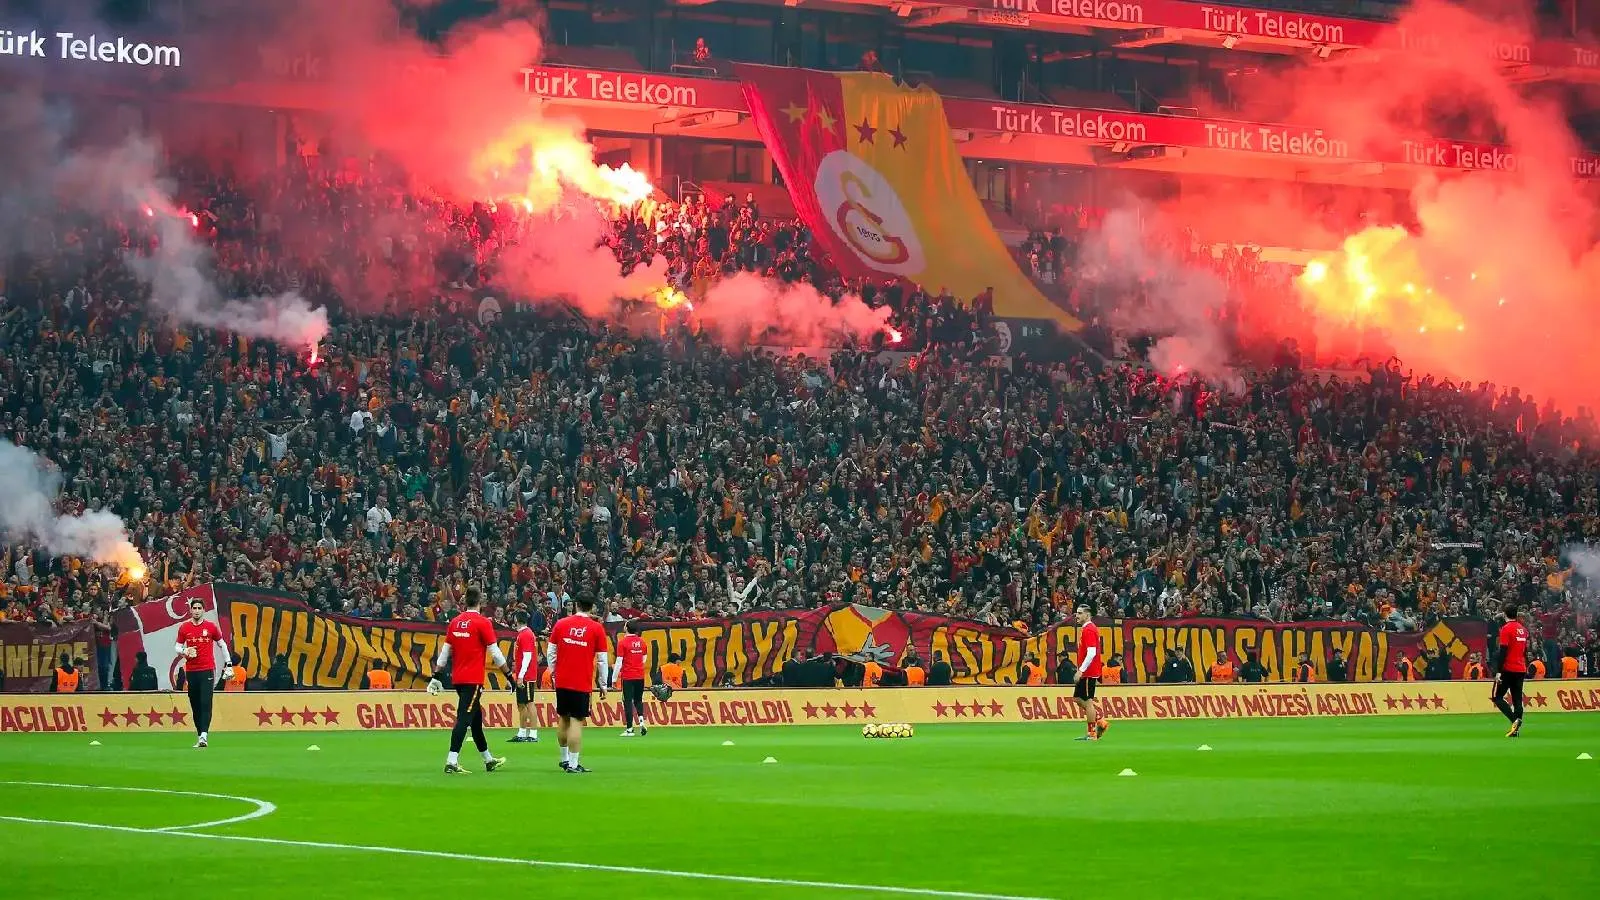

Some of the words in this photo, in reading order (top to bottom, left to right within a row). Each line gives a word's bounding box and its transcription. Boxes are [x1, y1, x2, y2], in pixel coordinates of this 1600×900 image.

[1201, 7, 1248, 33] Türk
[1255, 12, 1343, 43] Telekom
[56, 32, 180, 67] Telekom
[520, 68, 578, 97] Türk
[587, 73, 697, 105] Telekom
[992, 106, 1043, 134] Türk
[1051, 112, 1146, 141] Telekom
[1205, 124, 1252, 149] Türk
[1259, 128, 1348, 158] Telekom
[1402, 140, 1447, 166] Türk
[230, 601, 447, 689] RUHUNUZ
[356, 703, 513, 728] GALATASAY
[1151, 695, 1243, 718] STADYUM
[1242, 688, 1314, 716] MÜZESİ
